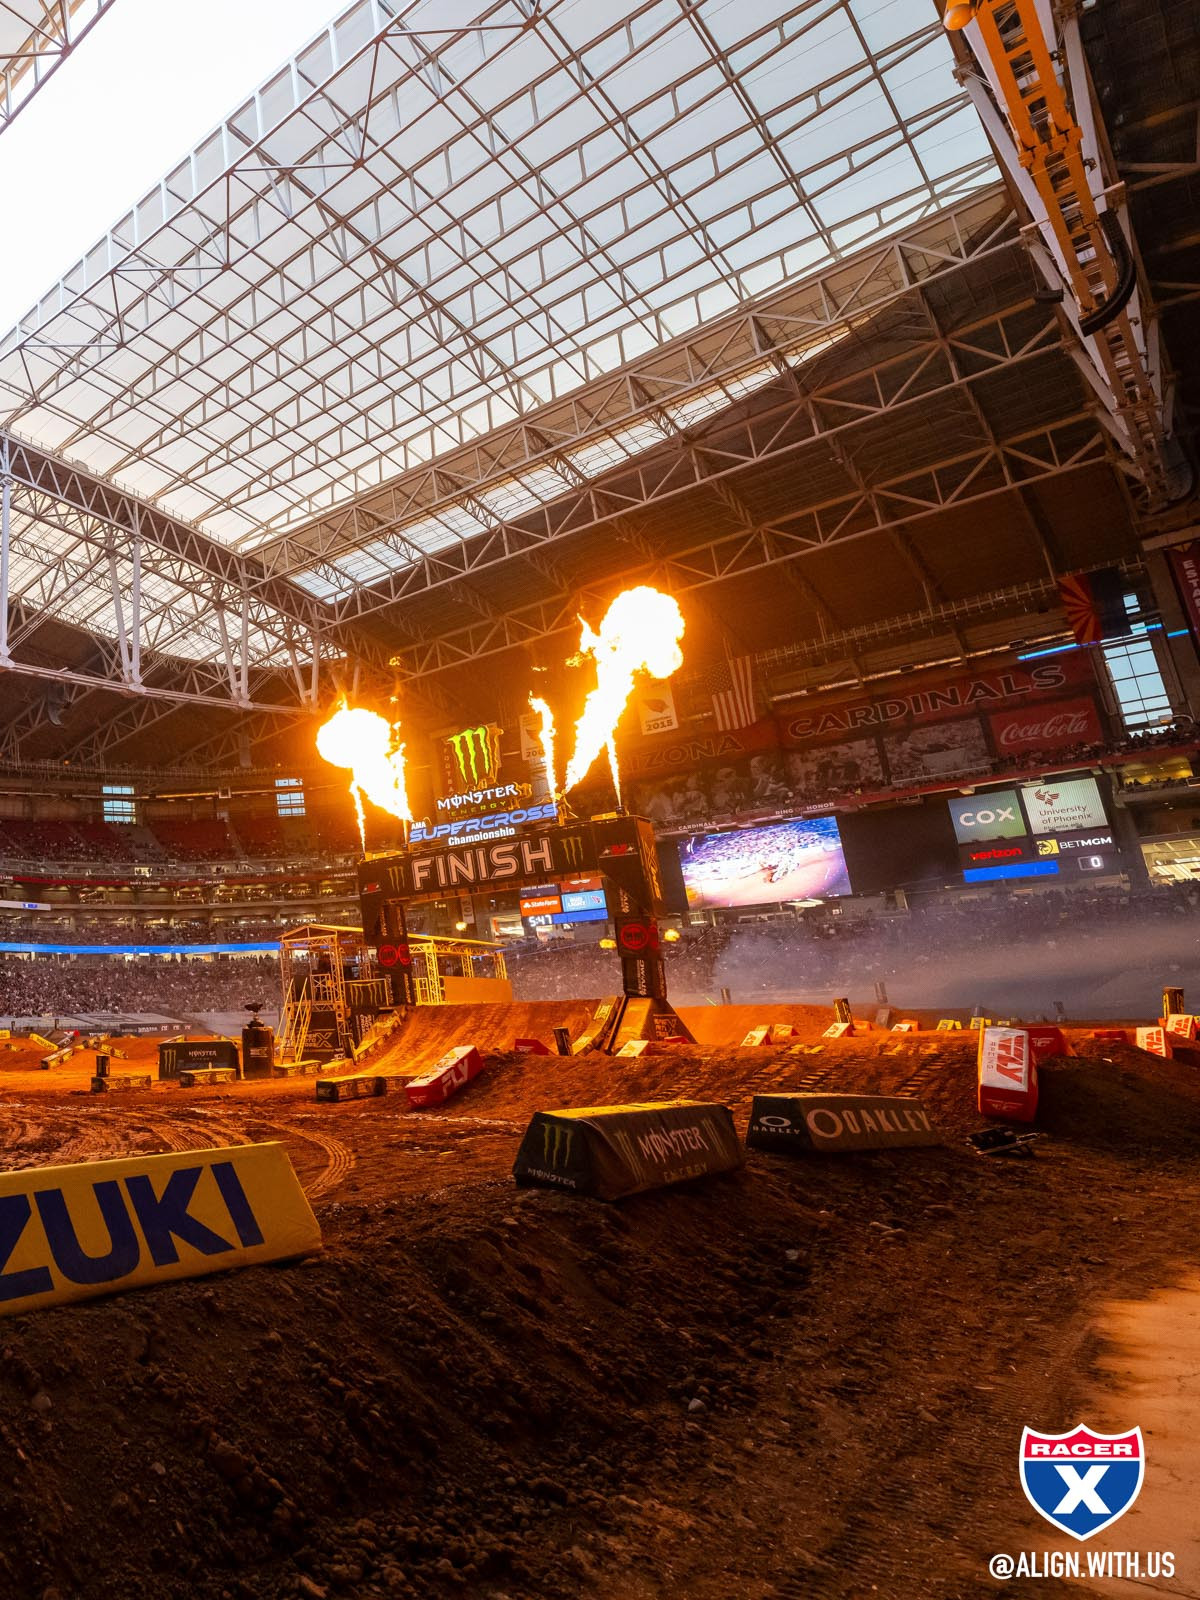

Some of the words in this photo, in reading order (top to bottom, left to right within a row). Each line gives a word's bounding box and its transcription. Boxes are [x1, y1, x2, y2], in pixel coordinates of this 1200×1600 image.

[788, 664, 1066, 739] CARDINALS
[646, 719, 673, 732] 2015
[1000, 711, 1090, 745] Coca-Cola
[437, 784, 518, 810] MONSTER
[451, 801, 506, 817] ENERGY
[775, 808, 794, 816] RING
[806, 802, 835, 811] HONOR
[959, 807, 1015, 826] COX
[1039, 803, 1087, 817] University
[410, 802, 558, 843] SUPERCROSS
[411, 821, 426, 831] AMA
[678, 820, 717, 831] CARDINALS
[1041, 815, 1051, 825] of
[1053, 812, 1093, 824] Phoenix
[448, 827, 515, 846] Championship
[1059, 836, 1112, 849] BETMGM
[970, 847, 1022, 860] verizon
[1091, 857, 1100, 867] 0
[411, 838, 556, 891] FINISH
[528, 914, 553, 928] 5:47
[997, 1035, 1025, 1084] FLY
[441, 1058, 468, 1096] FLY
[841, 1109, 934, 1134] OAKLEY
[752, 1126, 801, 1135] OAKLEY
[637, 1126, 710, 1164] MONSTER
[528, 1167, 576, 1189] MONSTER
